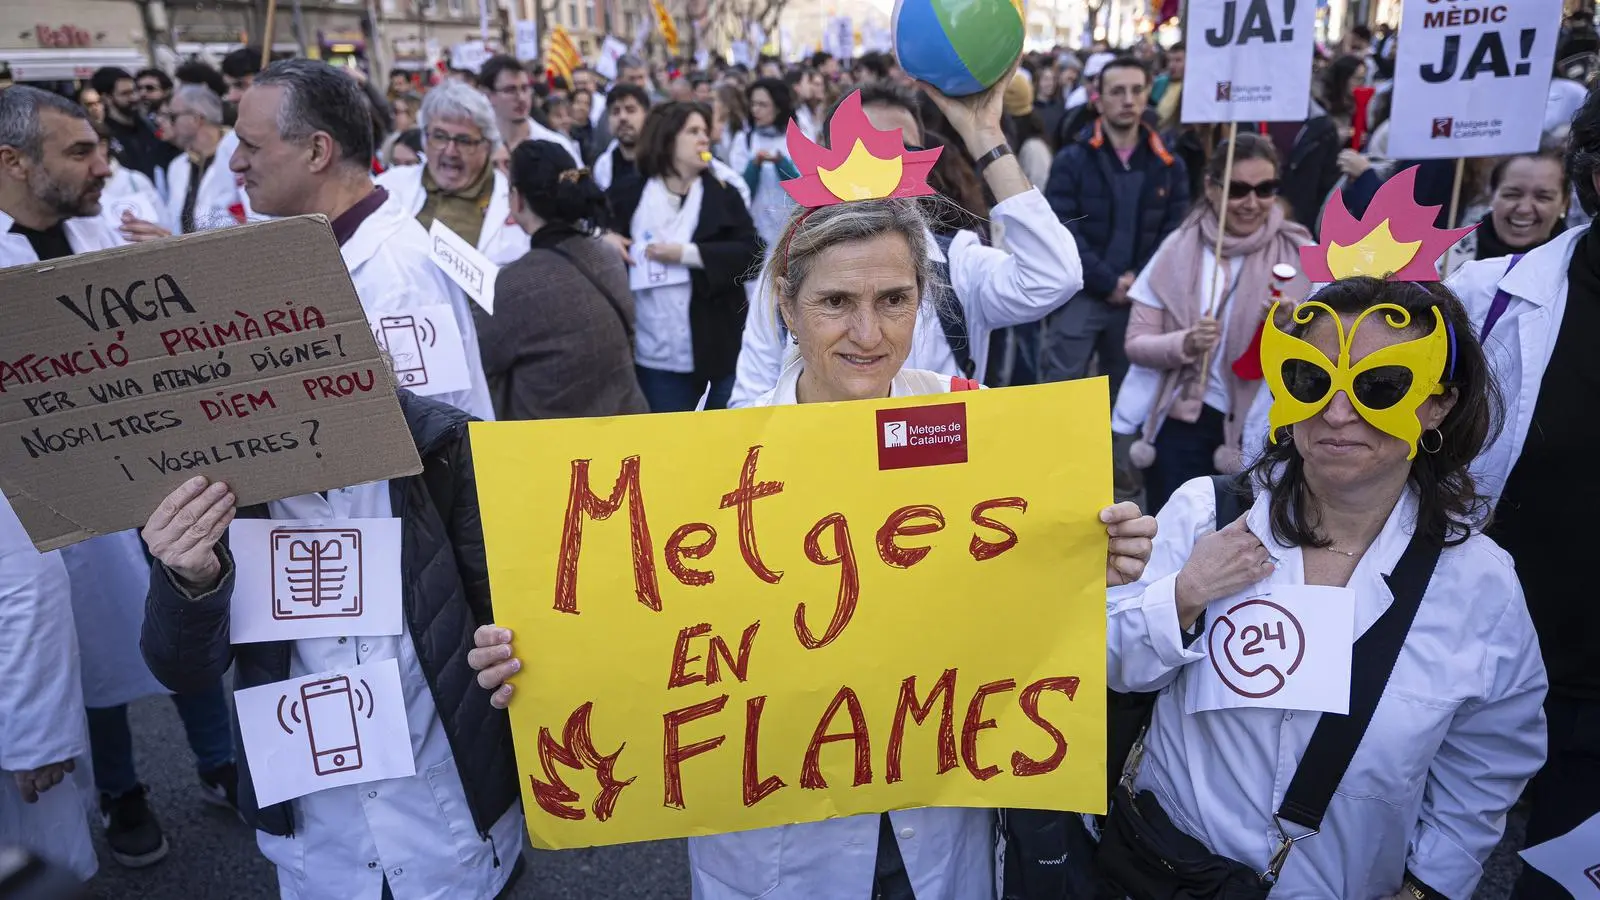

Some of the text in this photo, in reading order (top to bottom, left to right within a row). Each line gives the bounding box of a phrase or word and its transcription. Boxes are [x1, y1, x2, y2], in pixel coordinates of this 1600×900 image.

[1205, 0, 1296, 48] JA!
[1423, 5, 1508, 28] MÈDIC
[1420, 28, 1536, 83] JA!
[1491, 118, 1503, 127] de
[56, 274, 197, 331] VAGA
[21, 410, 183, 458] NOSALTRES
[302, 369, 375, 400] PROU
[23, 391, 76, 416] PER
[88, 378, 144, 404] UNA
[148, 419, 322, 475] VOSALTRES?
[909, 421, 961, 436] Metges de
[909, 433, 961, 446] Catalunya
[553, 445, 1028, 649] Metges
[667, 620, 760, 689] EN
[1240, 621, 1286, 656] 24
[663, 668, 1080, 810] FLAMES
